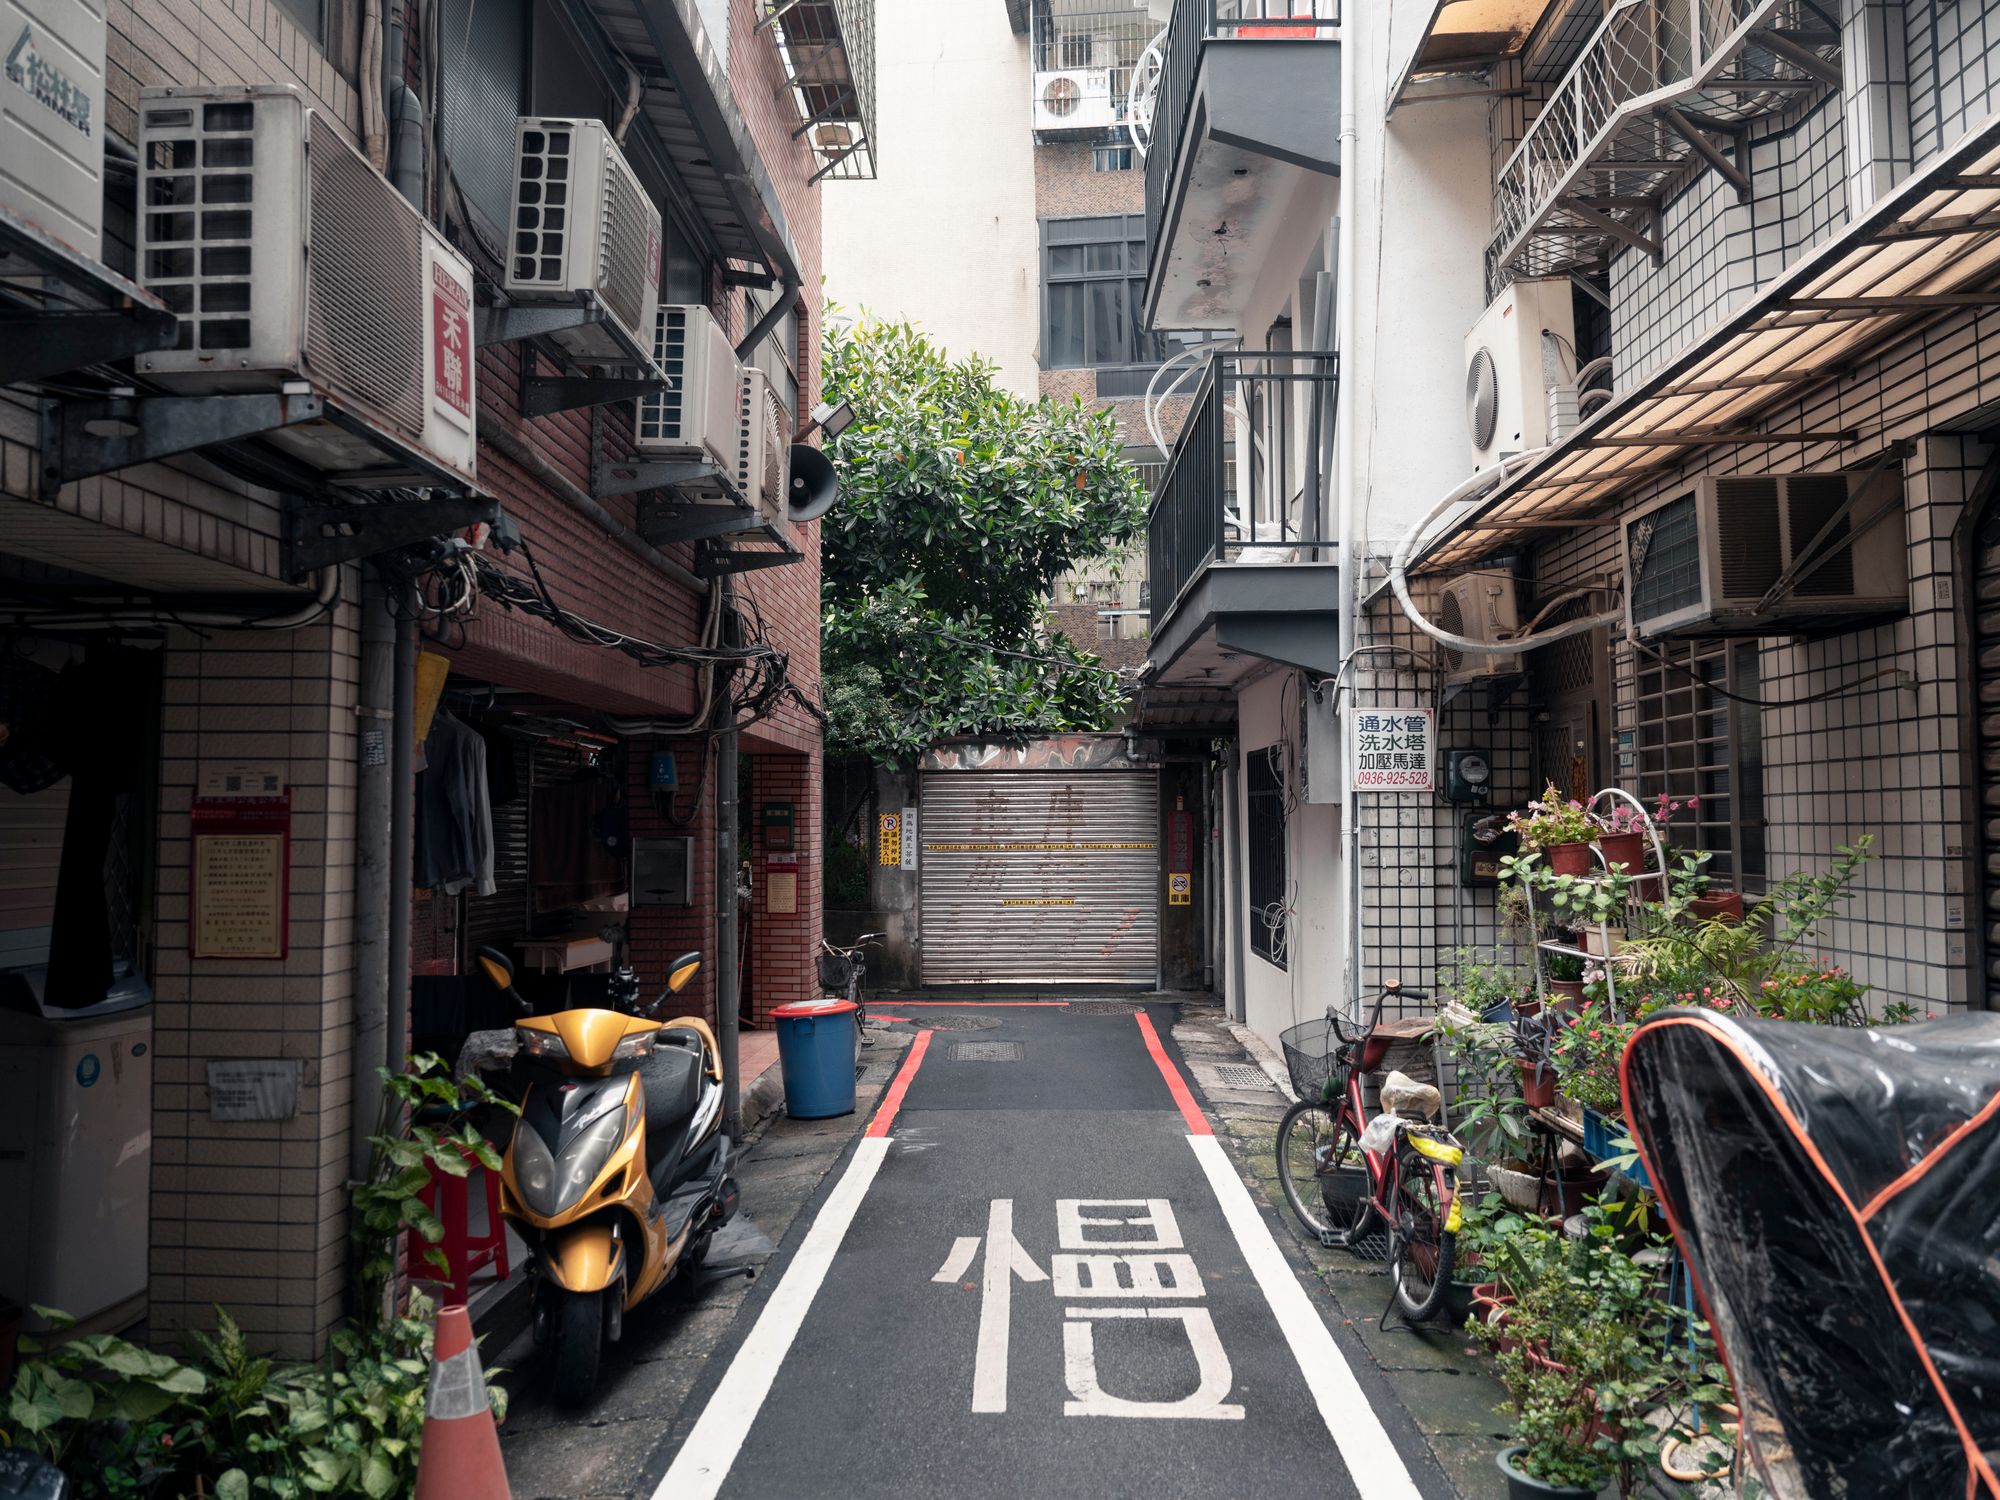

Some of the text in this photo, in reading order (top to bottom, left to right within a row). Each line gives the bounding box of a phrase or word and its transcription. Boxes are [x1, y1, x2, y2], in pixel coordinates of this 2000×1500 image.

[435, 266, 468, 310] HERAN
[442, 305, 463, 394] 禾聯
[1358, 715, 1426, 733] 通水管
[1358, 734, 1426, 751] 洗水塔
[1358, 753, 1426, 770] 加壓馬達
[1358, 771, 1428, 785] 0936-925-528
[882, 831, 890, 863] 車庫出入口
[890, 831, 898, 863] 請勿停車
[1171, 894, 1189, 903] 車庫
[931, 1198, 1246, 1420] 慢
